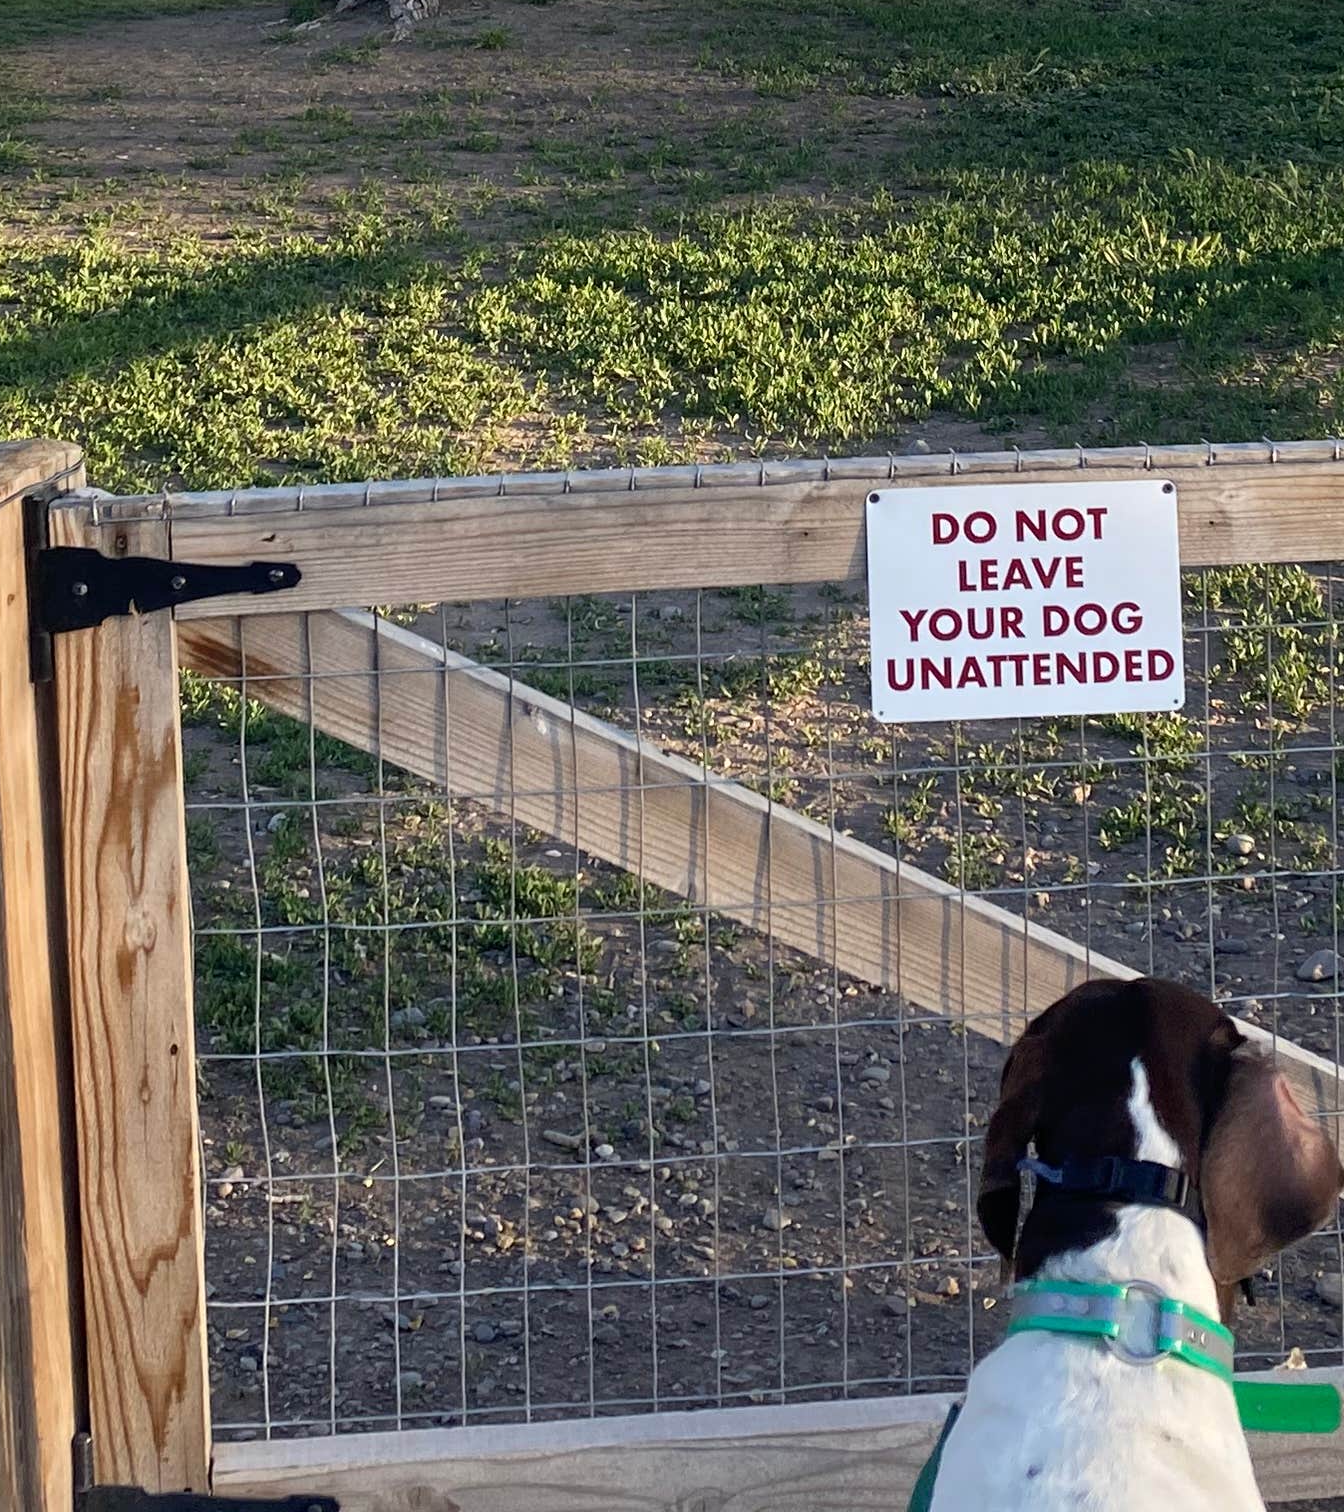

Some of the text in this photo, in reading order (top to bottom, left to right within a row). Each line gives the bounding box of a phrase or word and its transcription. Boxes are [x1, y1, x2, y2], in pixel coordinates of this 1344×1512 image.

[931, 507, 1108, 545] DO NOT
[958, 556, 1084, 592] LEAVE
[899, 602, 1143, 642] YOUR DOG
[887, 649, 1175, 692] UNATTENDED
